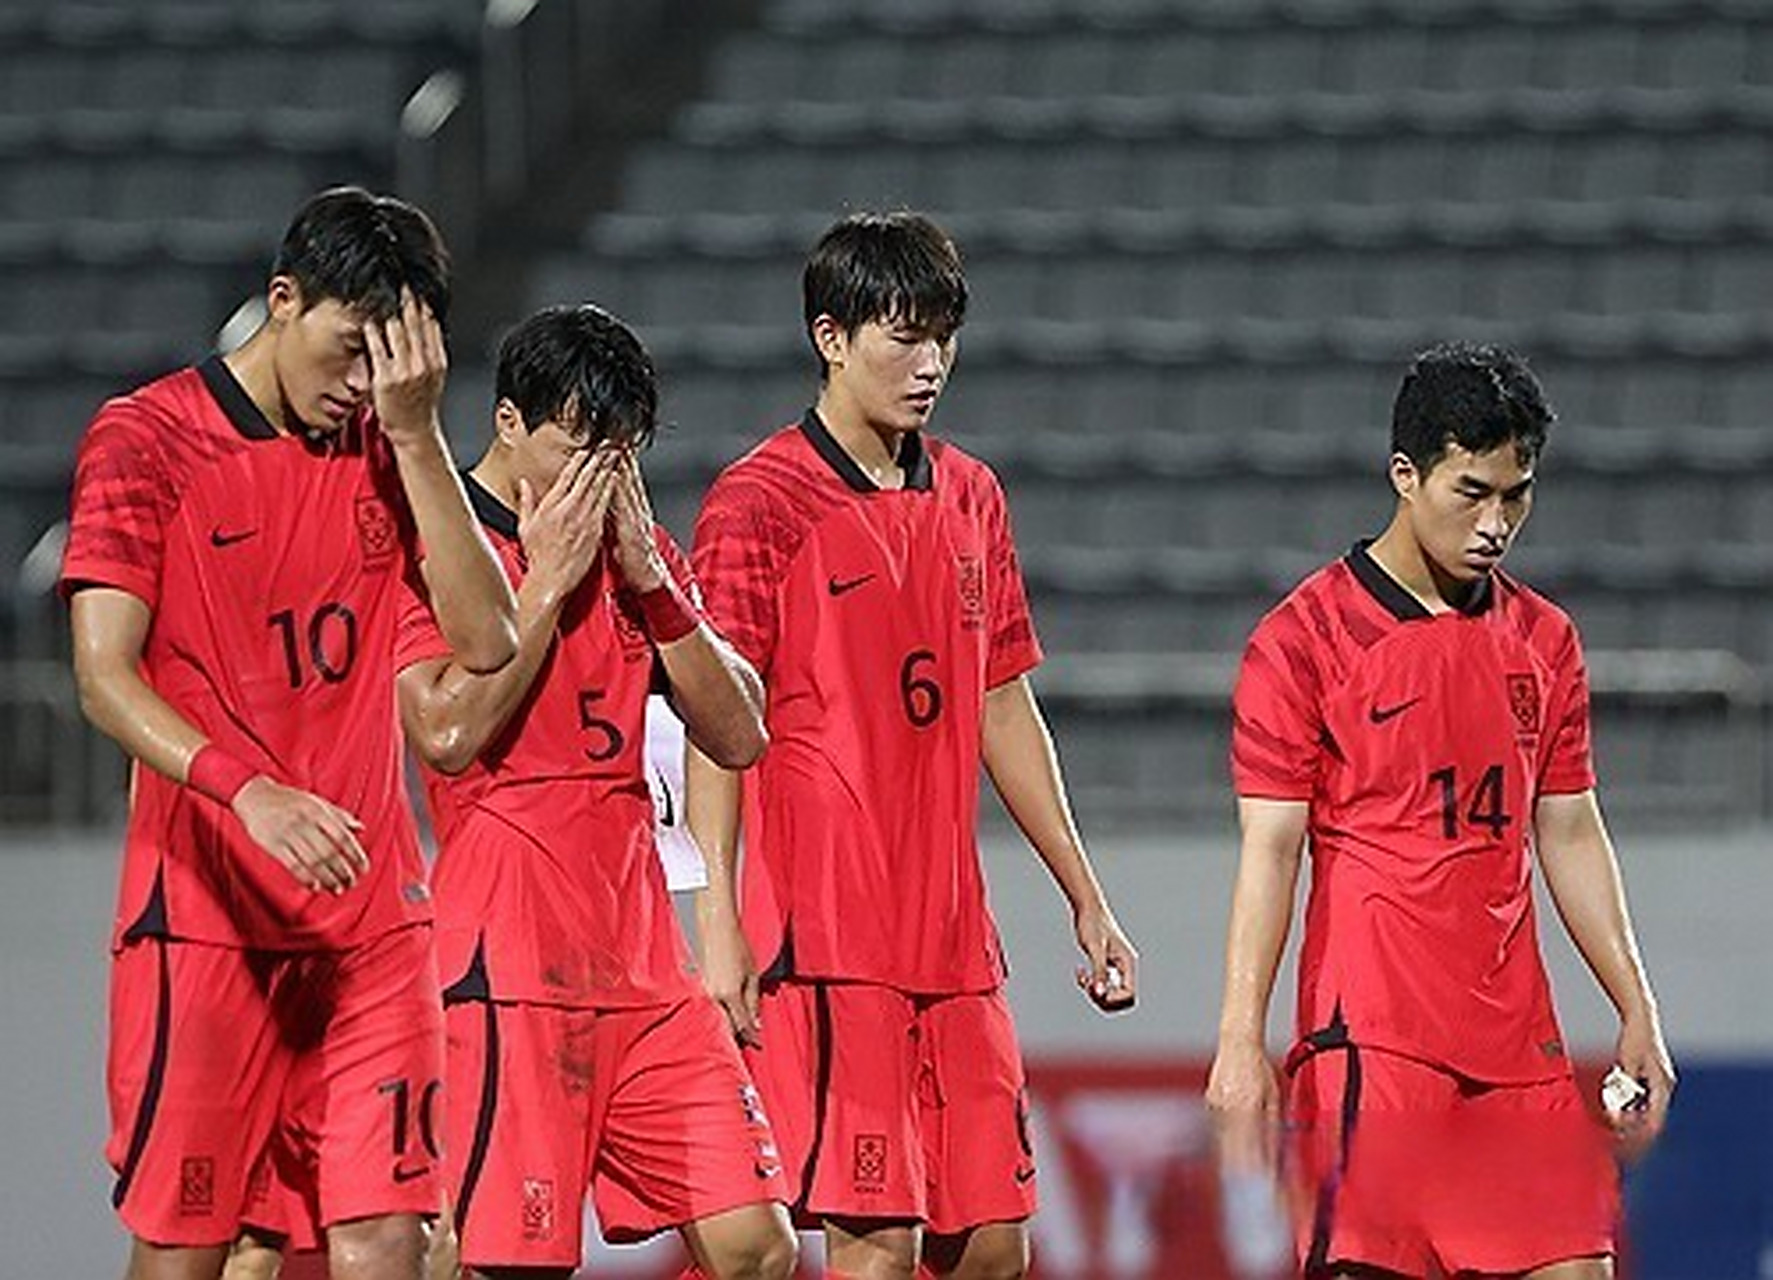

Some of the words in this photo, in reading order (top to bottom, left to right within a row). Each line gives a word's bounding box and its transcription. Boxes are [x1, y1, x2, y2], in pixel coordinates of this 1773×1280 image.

[267, 602, 356, 687] 10
[578, 690, 624, 761] 5
[901, 650, 942, 726] 6
[1430, 765, 1511, 840] 14
